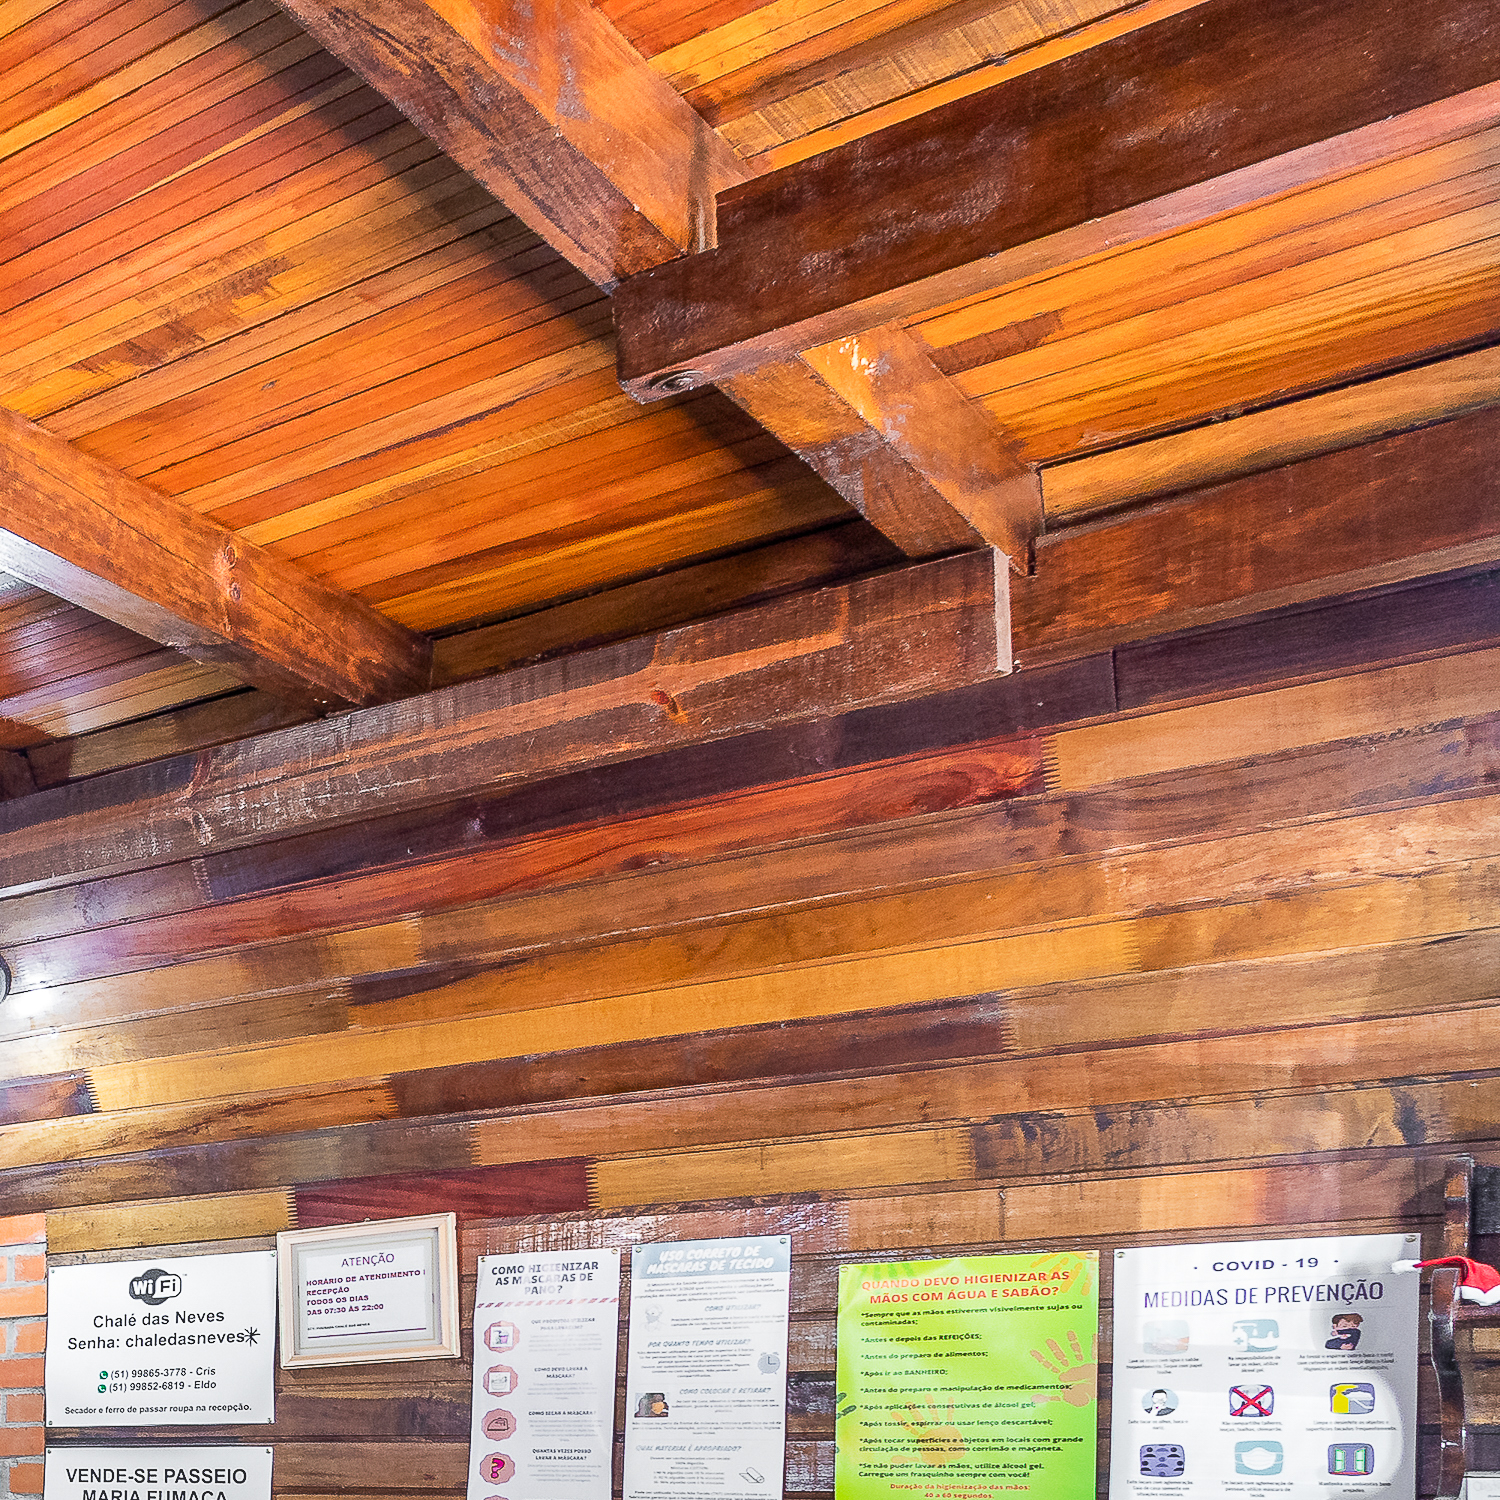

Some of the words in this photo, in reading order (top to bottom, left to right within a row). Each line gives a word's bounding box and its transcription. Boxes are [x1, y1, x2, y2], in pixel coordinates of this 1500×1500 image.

[341, 1252, 395, 1268] ATENÇÃO
[659, 1250, 683, 1262] USO
[686, 1247, 741, 1260] CORRETO
[743, 1245, 762, 1257] DE
[491, 1265, 525, 1275] COMO
[528, 1261, 599, 1273] HIGIENIZAR
[709, 1260, 727, 1271] DE
[729, 1257, 775, 1270] TECIDO
[1212, 1259, 1275, 1272] COVID
[1295, 1257, 1319, 1269] 19
[359, 1269, 421, 1281] ATENDIMENTO
[495, 1276, 509, 1286] AS
[579, 1272, 594, 1281] DE
[862, 1279, 920, 1291] QUANDO
[924, 1276, 960, 1287] DEVO
[964, 1272, 1047, 1284] HIGIENIZAR
[1051, 1271, 1070, 1280] AS
[306, 1286, 350, 1296] RECEPÇÃO
[524, 1285, 563, 1295] PANO?
[870, 1292, 909, 1304] MÃOS
[912, 1292, 943, 1302] COM
[947, 1289, 987, 1300] ÁGUA
[991, 1289, 998, 1298] E
[1002, 1285, 1059, 1298] SABÃO?
[1144, 1288, 1229, 1309] MEDIDAS
[1234, 1287, 1258, 1305] DE
[1265, 1278, 1384, 1305] PREVENÇÃO
[306, 1297, 334, 1306] TODOS
[335, 1296, 347, 1304] OS
[349, 1294, 369, 1302] DIAS
[361, 1303, 384, 1312] 22:00
[93, 1313, 137, 1328] Chalé
[142, 1312, 170, 1325] das
[175, 1310, 225, 1324] Neves
[67, 1336, 120, 1350] Senha:
[895, 1335, 921, 1343] depois
[110, 1370, 129, 1380] (51)
[131, 1368, 187, 1379] 99865-3778
[195, 1366, 216, 1376] Cris
[109, 1383, 127, 1393] (51)
[130, 1381, 185, 1392] 99852-6819
[194, 1380, 217, 1389] Eldo
[64, 1405, 97, 1415] Secador
[105, 1404, 125, 1414] ferro
[127, 1404, 137, 1413] de
[139, 1406, 168, 1415] passar
[169, 1405, 194, 1414] roupa
[195, 1404, 207, 1412] na
[208, 1402, 252, 1413] recepção.
[960, 1437, 990, 1445] objetos
[1052, 1436, 1084, 1444] grande
[65, 1468, 158, 1484] VENDE-SE
[164, 1468, 247, 1485] PASSEIO
[890, 1483, 923, 1491] Duração
[936, 1483, 987, 1491] higienização
